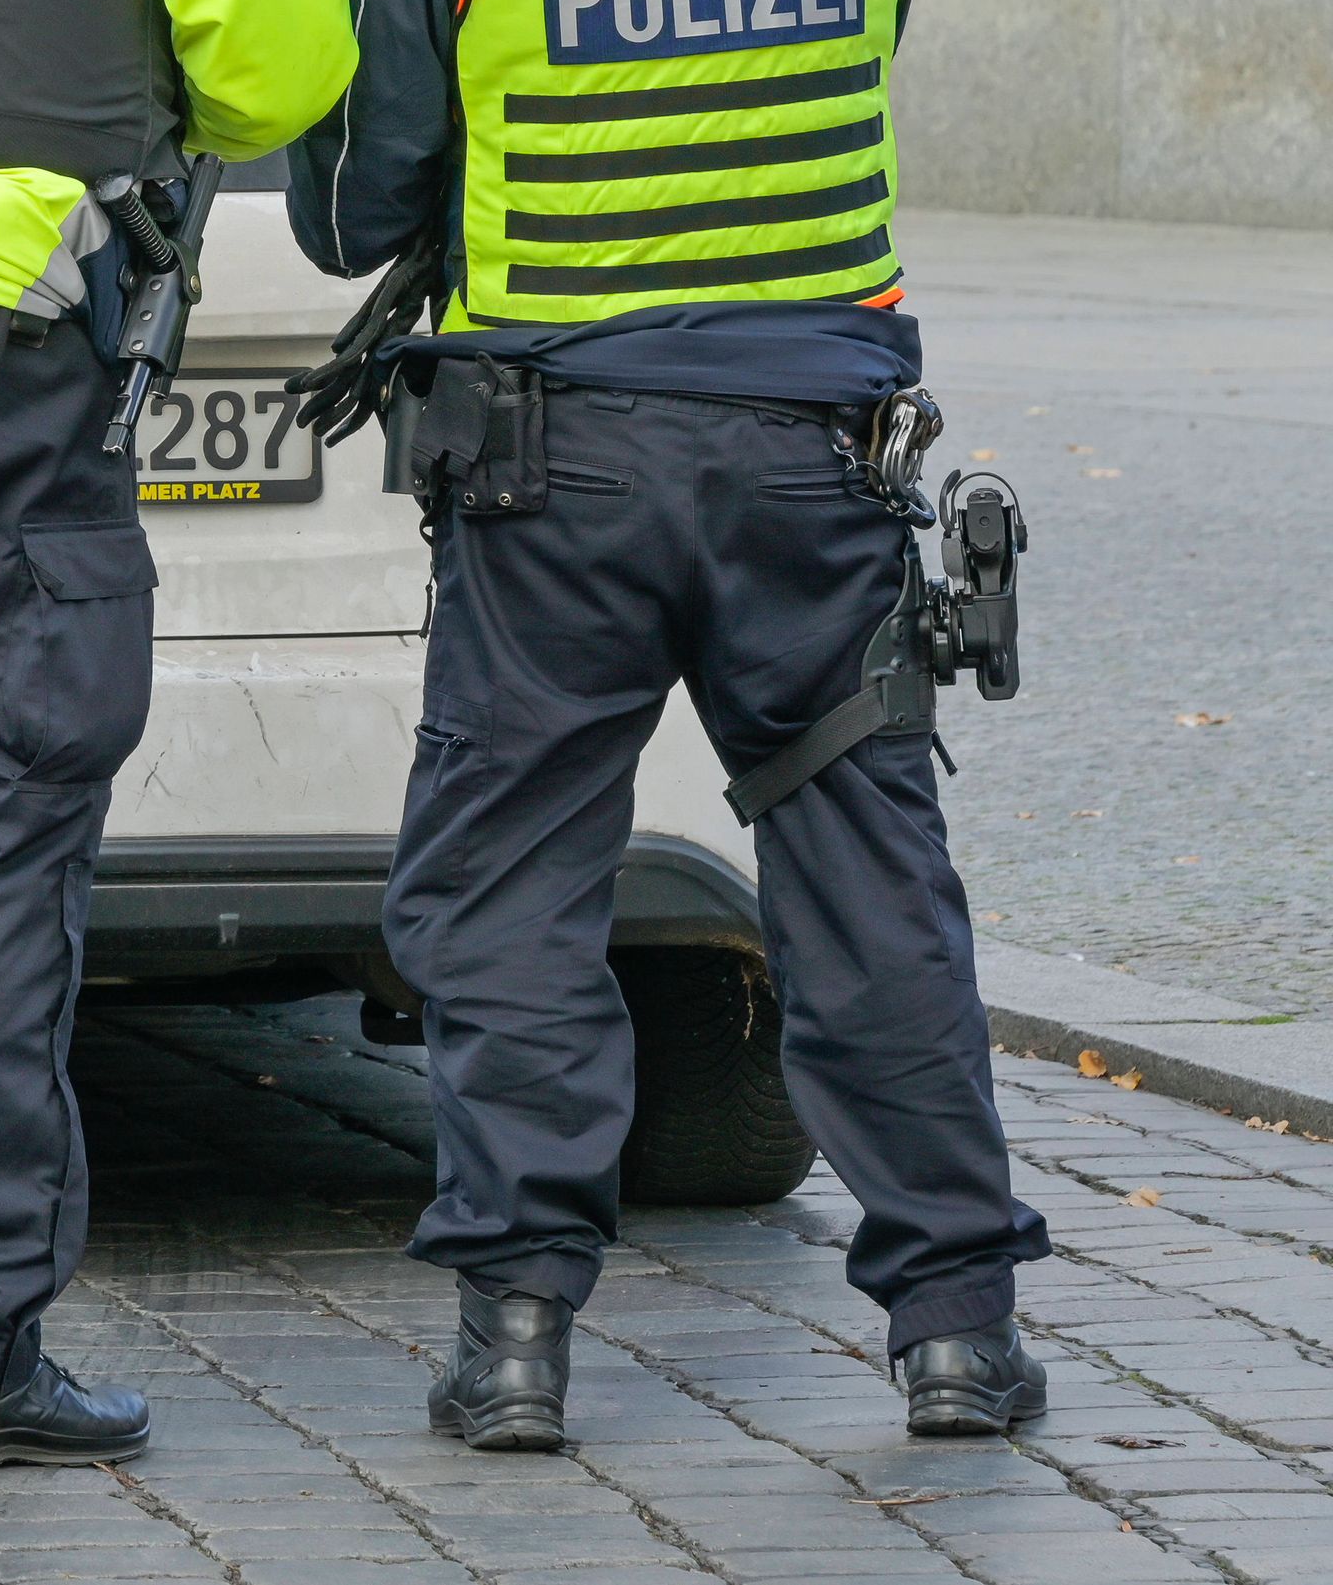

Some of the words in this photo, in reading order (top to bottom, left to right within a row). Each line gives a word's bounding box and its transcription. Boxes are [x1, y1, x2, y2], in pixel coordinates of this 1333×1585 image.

[136, 390, 301, 471] 287
[137, 483, 187, 501] MER
[193, 482, 261, 500] PLATZ
